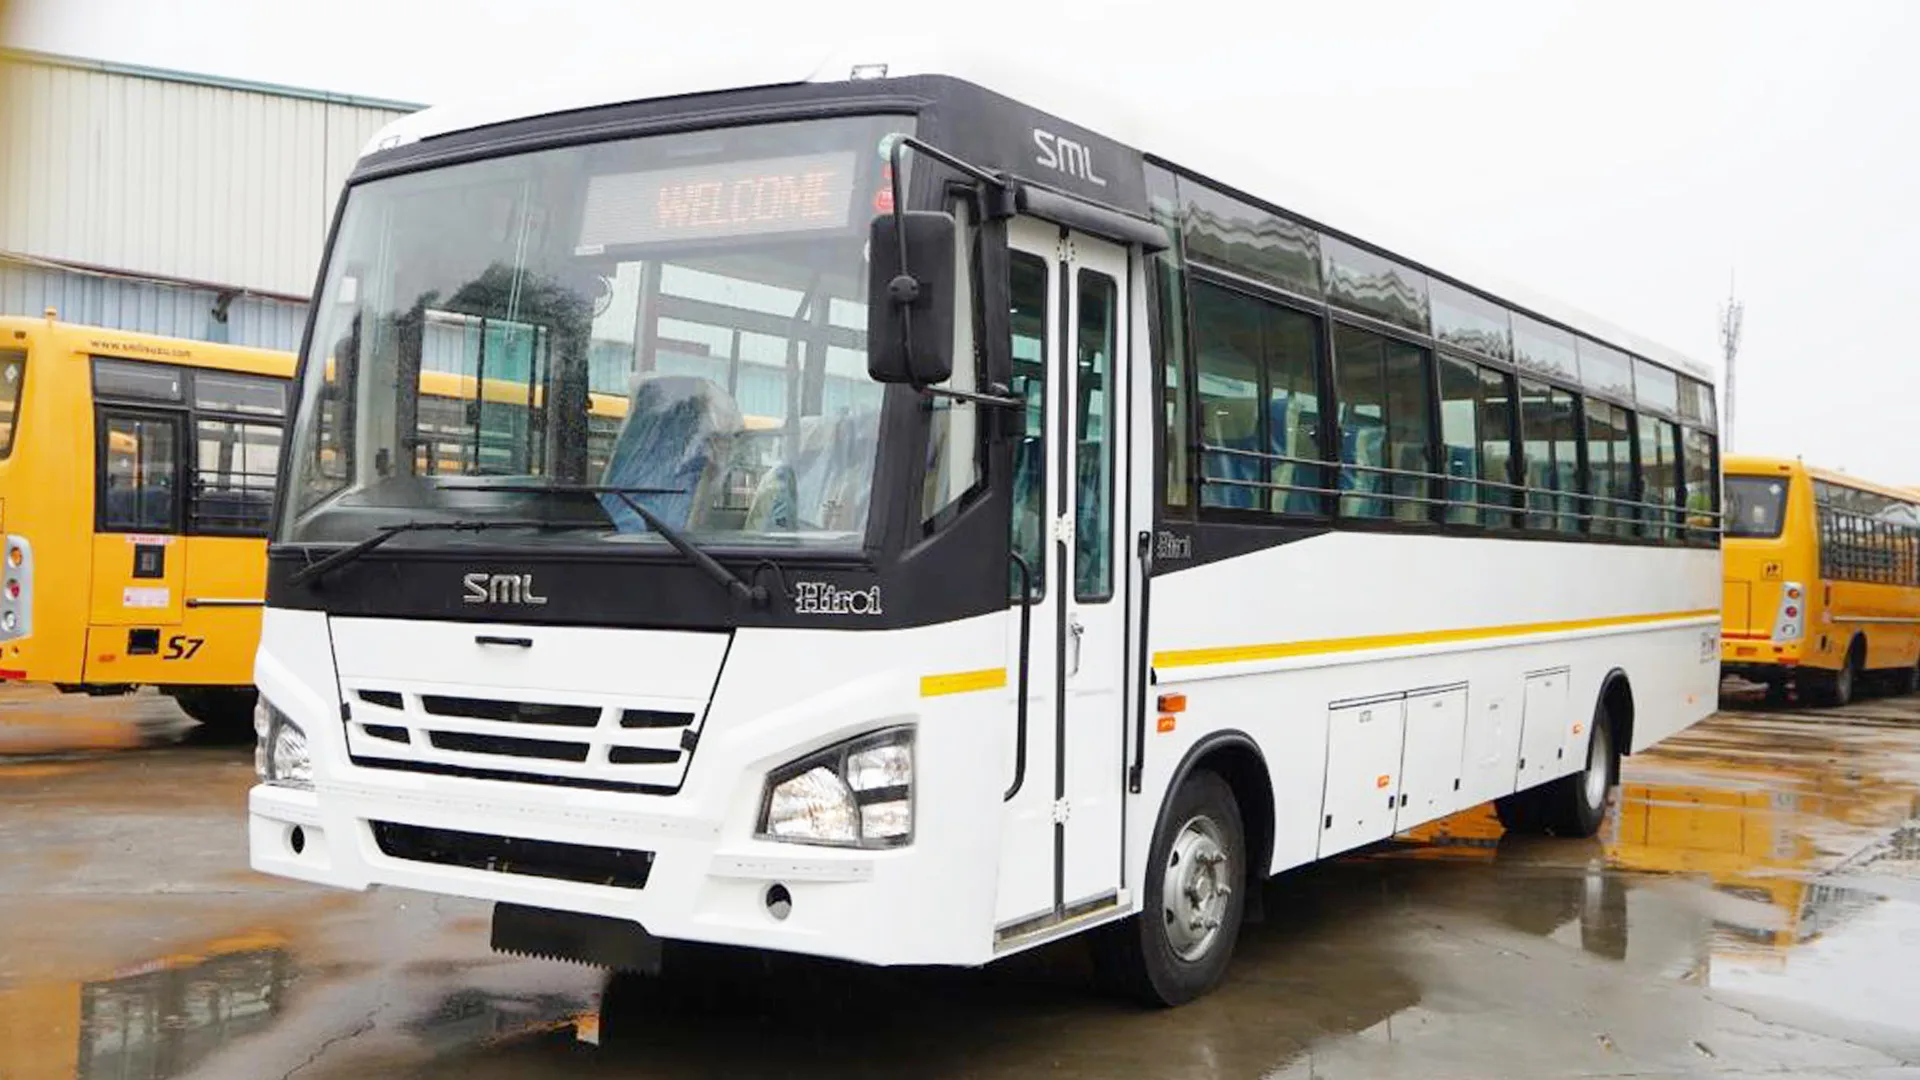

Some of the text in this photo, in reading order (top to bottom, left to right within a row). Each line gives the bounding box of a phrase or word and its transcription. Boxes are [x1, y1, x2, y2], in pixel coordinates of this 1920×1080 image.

[1034, 128, 1107, 187] SML
[658, 170, 839, 229] WELCOME
[463, 573, 547, 604] SML
[163, 635, 204, 659] S7
